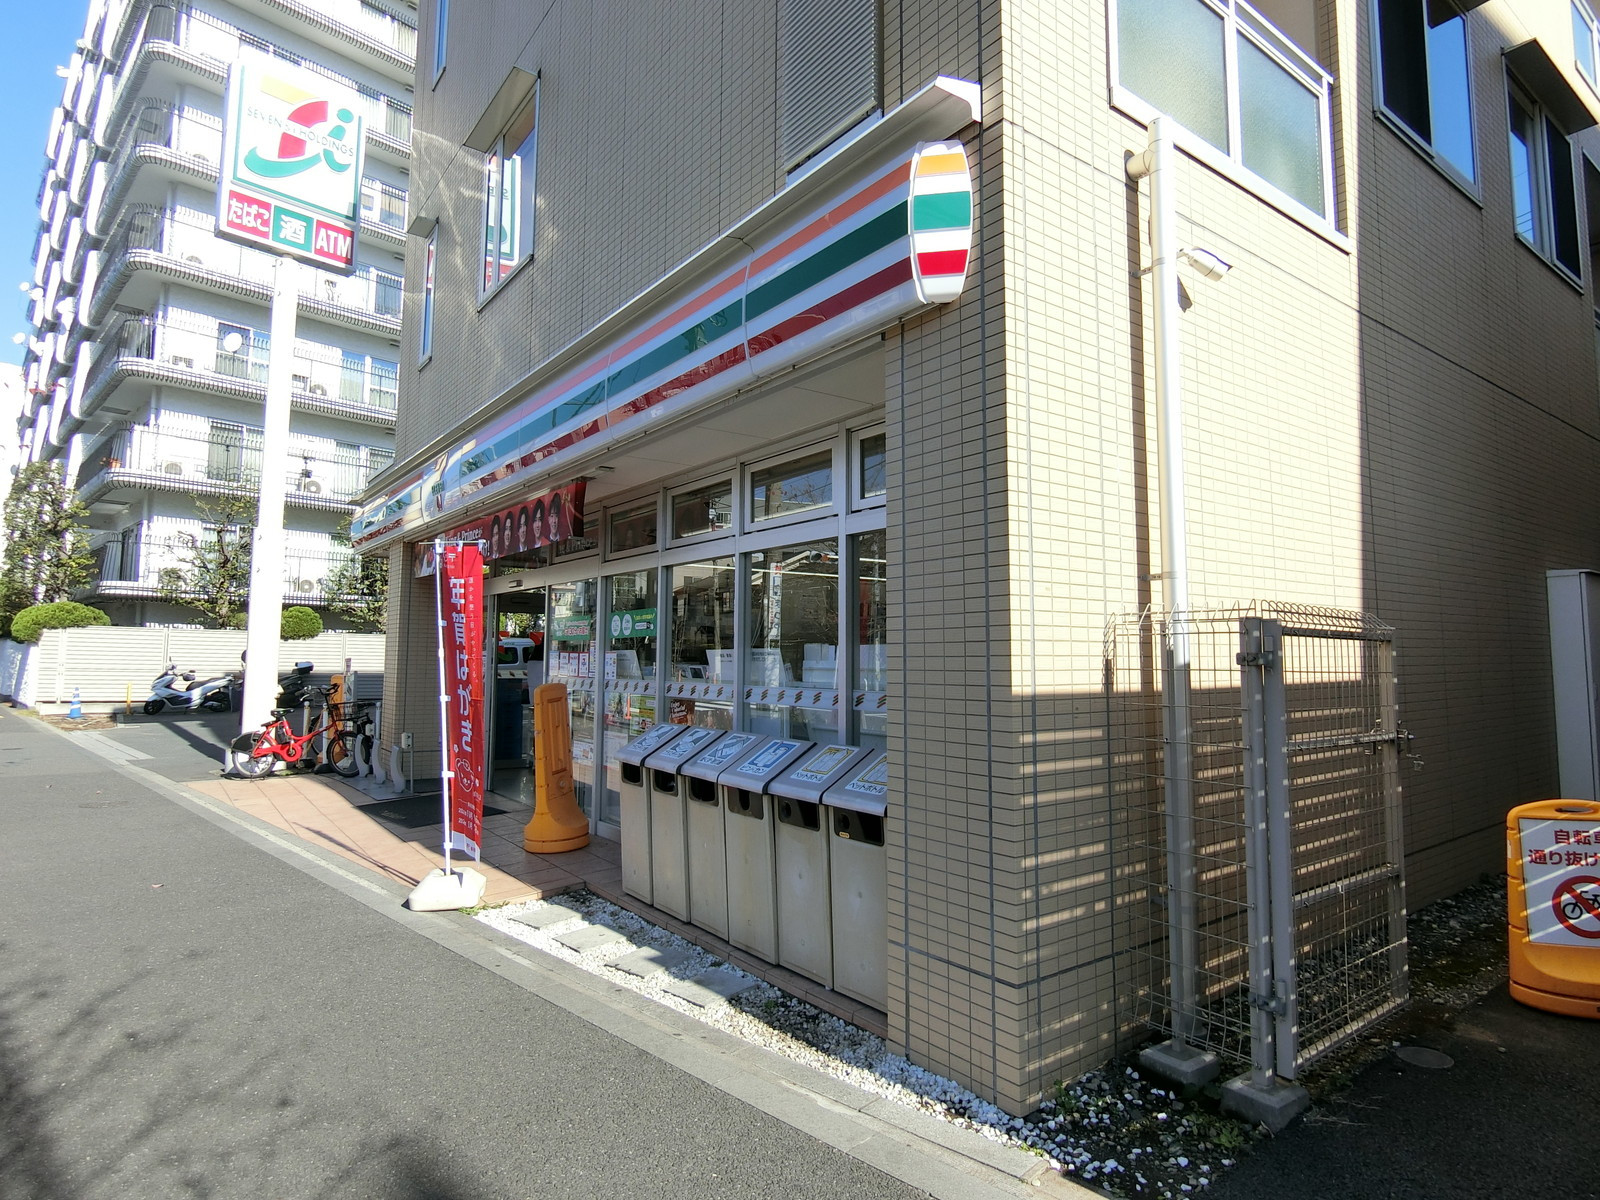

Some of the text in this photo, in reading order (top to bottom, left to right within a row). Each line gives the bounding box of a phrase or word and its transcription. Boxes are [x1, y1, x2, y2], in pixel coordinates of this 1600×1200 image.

[299, 128, 354, 157] HOLDINGS
[228, 198, 270, 232] たばこ
[279, 214, 307, 244] 酒
[316, 228, 351, 258] ATM
[450, 576, 472, 753] 年賀はがき
[849, 782, 885, 793] ペットボトル
[1528, 848, 1598, 866] 通り抜け
